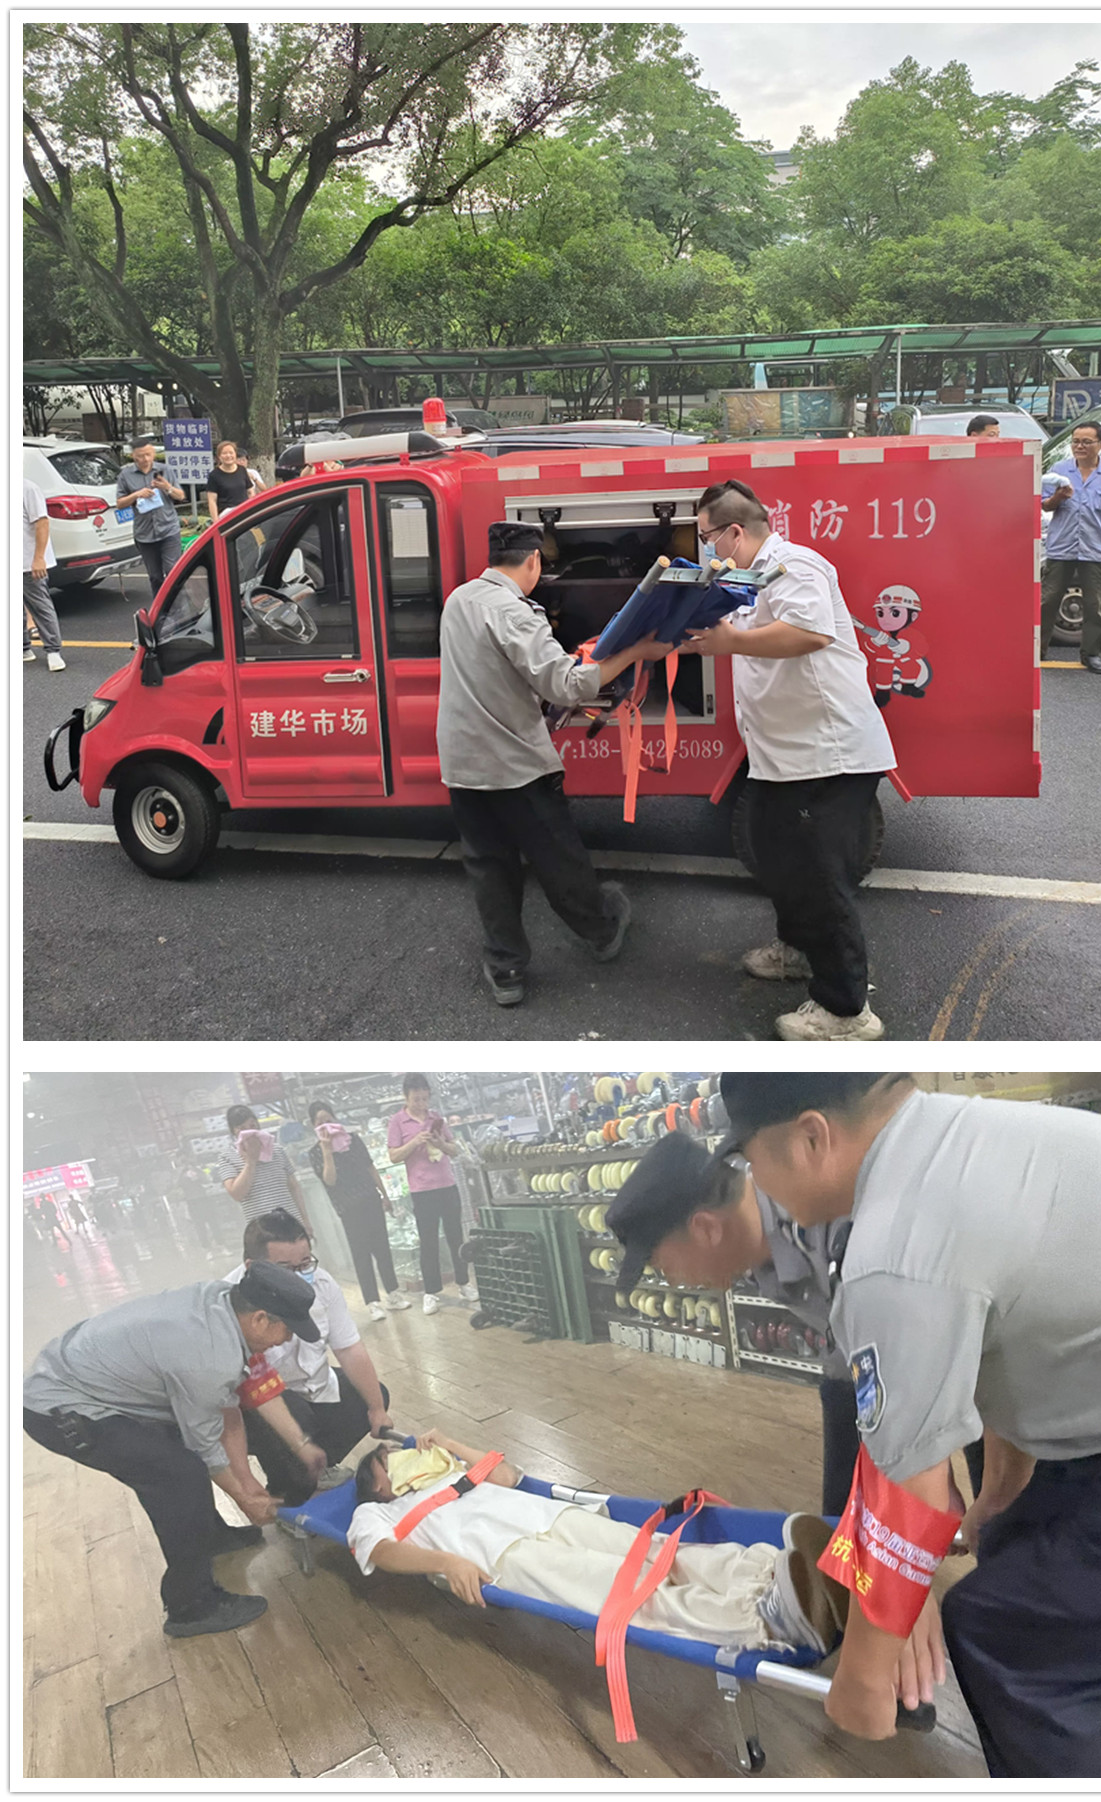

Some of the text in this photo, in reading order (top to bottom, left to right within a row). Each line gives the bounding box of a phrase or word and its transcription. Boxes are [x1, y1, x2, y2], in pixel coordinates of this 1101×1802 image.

[165, 423, 209, 435] 货物临时
[171, 436, 205, 448] 堆放处
[168, 455, 211, 466] 临时停车
[867, 497, 937, 539] 119
[250, 708, 369, 738] 建华市场
